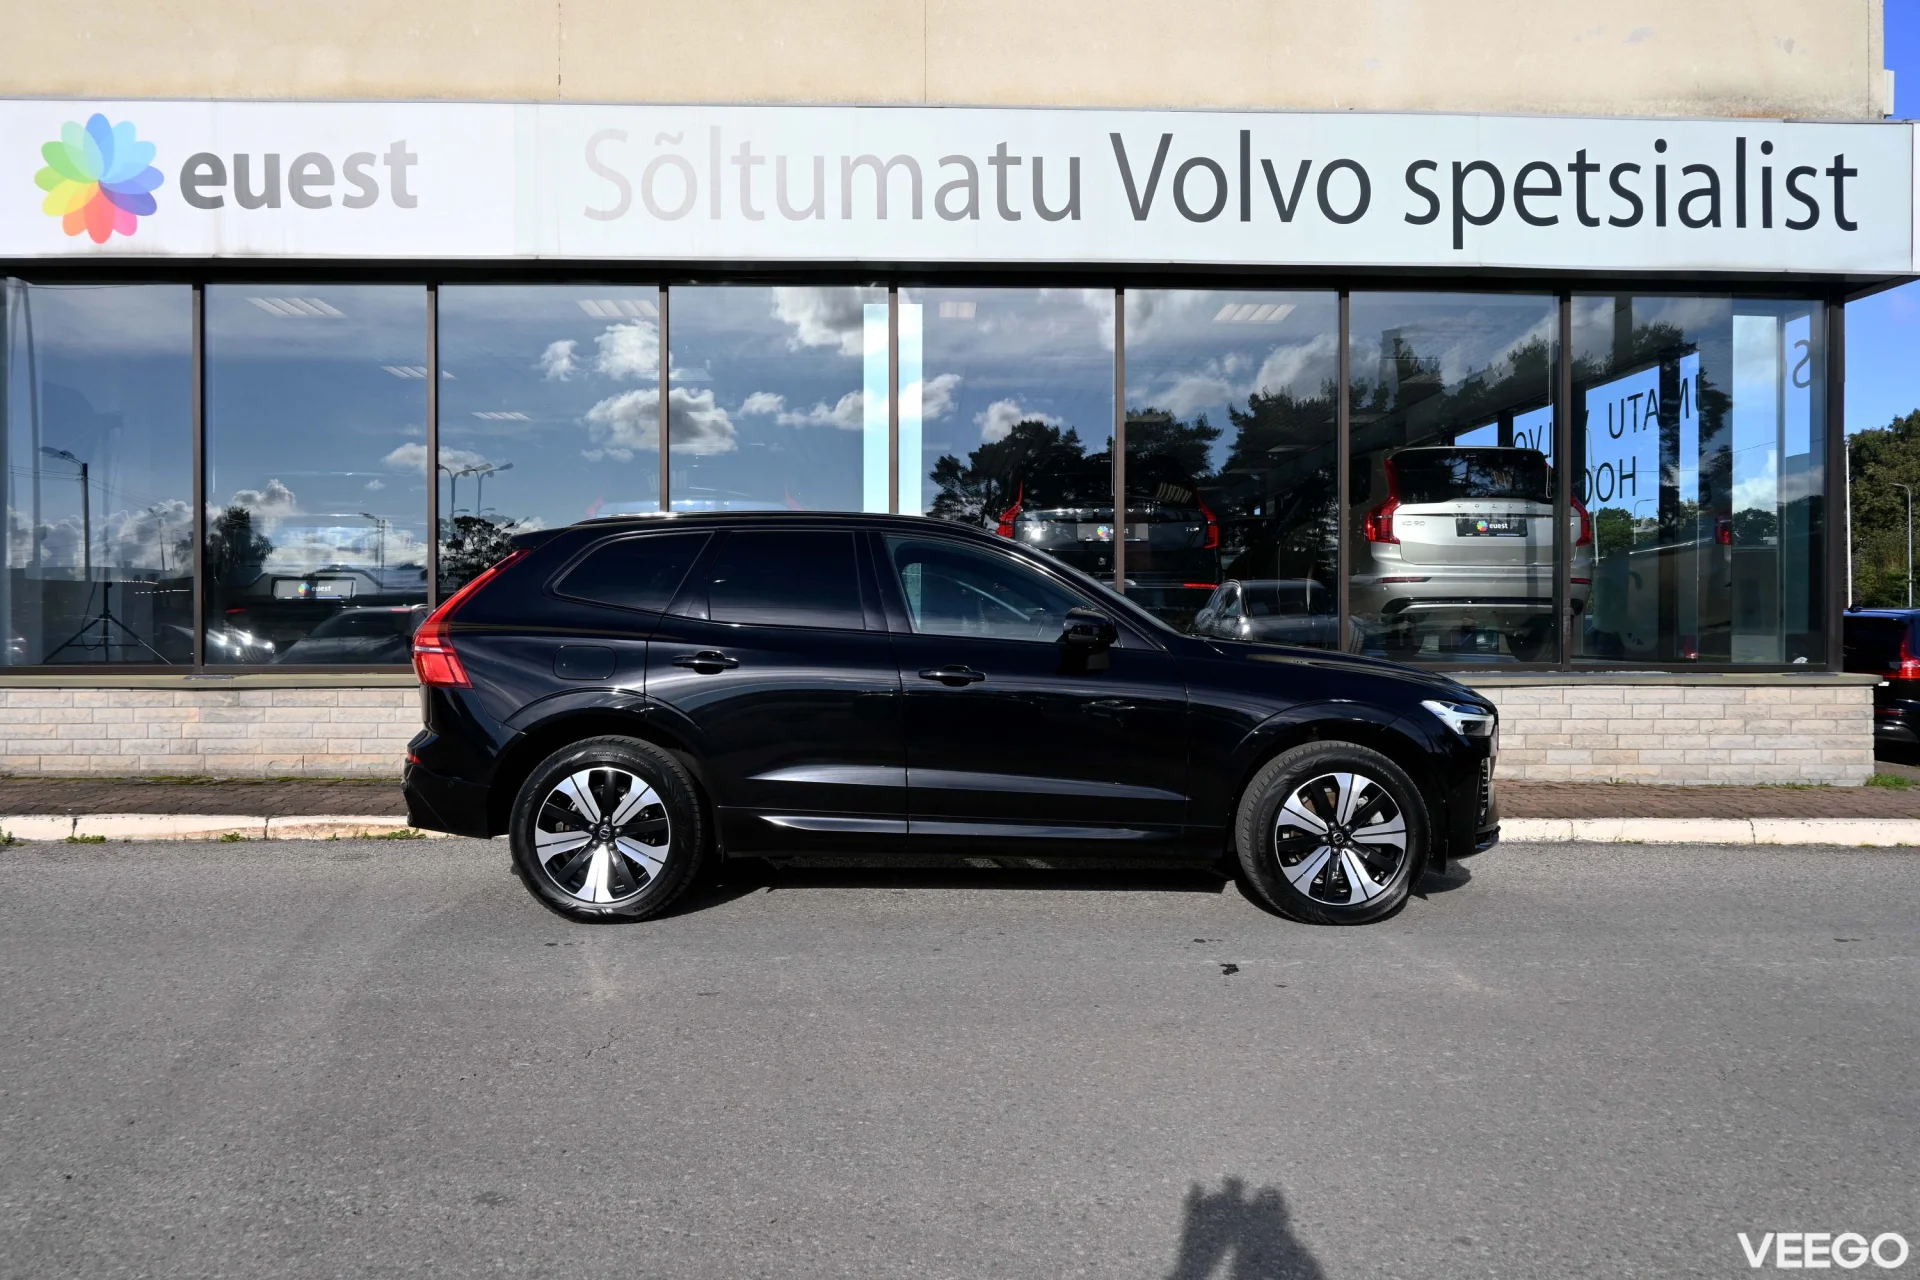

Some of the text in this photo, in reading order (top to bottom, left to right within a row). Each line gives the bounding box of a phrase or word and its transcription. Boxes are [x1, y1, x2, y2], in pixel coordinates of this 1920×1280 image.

[180, 139, 418, 210] euest
[582, 126, 1859, 251] Sõltumatu Volvo spetsialist
